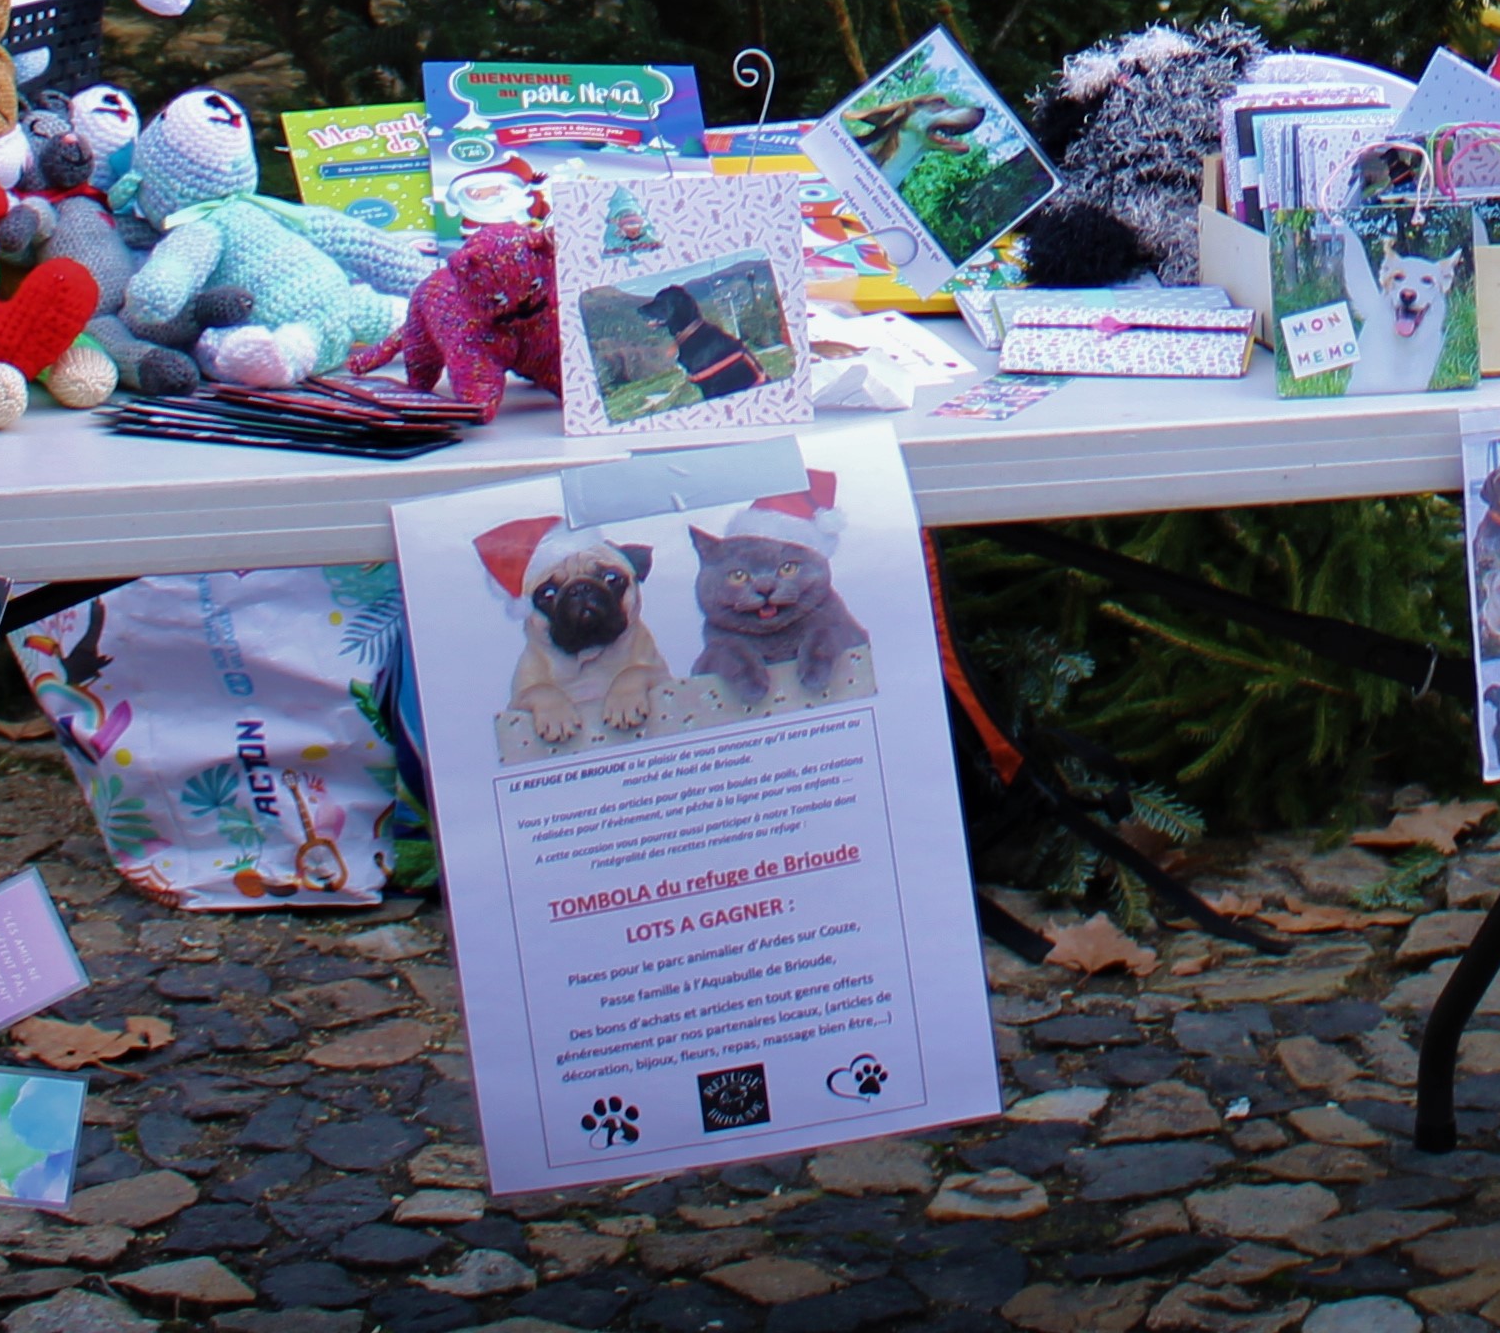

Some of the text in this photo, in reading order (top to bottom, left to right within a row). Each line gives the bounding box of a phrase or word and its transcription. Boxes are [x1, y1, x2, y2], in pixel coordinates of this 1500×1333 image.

[468, 73, 572, 85] BIENVENUE
[499, 89, 517, 97] au
[521, 85, 575, 108] pôle
[308, 121, 373, 149] Mes
[387, 133, 420, 154] de
[1292, 310, 1342, 339] MON
[1297, 340, 1356, 366] MEMO
[509, 780, 522, 794] LE
[522, 773, 563, 791] REFUGE
[564, 770, 579, 783] DE
[579, 761, 627, 780] BRIOUDE
[627, 761, 635, 771] a
[636, 758, 646, 769] le
[647, 753, 678, 769] plaisir
[678, 750, 692, 761] de
[693, 746, 716, 758] vous
[717, 737, 763, 754] annoncer
[787, 729, 808, 741] sera
[809, 720, 846, 738] présent
[847, 719, 861, 729] au
[622, 770, 660, 788] marché
[660, 768, 674, 781] de
[675, 763, 699, 778] Noël
[699, 761, 713, 774] de
[517, 817, 542, 830] Vous
[543, 816, 551, 828] y
[551, 806, 598, 824] trouverez
[598, 802, 617, 815] des
[617, 796, 654, 812] articles
[654, 791, 679, 806] pour
[679, 786, 707, 802] gâter
[708, 782, 725, 794] vos
[726, 776, 759, 791] boules
[759, 772, 773, 784] de
[800, 764, 818, 776] des
[819, 756, 864, 773] créations
[547, 841, 861, 919] TOMBOLA du refuge de Brioude
[625, 898, 784, 944] LOTS A GAGNER
[12, 936, 33, 965] AMIS
[26, 965, 41, 983] NE
[567, 970, 608, 987] Places
[609, 964, 640, 982] pour
[642, 960, 655, 973] le
[656, 956, 685, 973] parc
[686, 944, 745, 965] animalier
[796, 929, 817, 944] sur
[818, 921, 861, 938] Couze,
[599, 993, 636, 1009] Passe
[637, 983, 681, 1001] famille
[683, 980, 692, 993] à
[765, 963, 782, 977] de
[784, 953, 837, 974] Brioude,
[556, 990, 892, 1067] généreusement par nos partenaires locaux, (articles de
[569, 1028, 594, 1042] Des
[595, 1022, 627, 1037] bons
[683, 1007, 698, 1021] et
[699, 1000, 745, 1018] articles
[746, 996, 764, 1008] en
[764, 989, 793, 1005] tout
[794, 983, 830, 1002] genre
[832, 974, 874, 992] offerts
[561, 1063, 634, 1084] décoration,
[635, 1055, 678, 1072] bijoux,
[679, 1047, 720, 1062] fleurs,
[721, 1039, 761, 1055] repas,
[762, 1028, 816, 1047] massage
[818, 1022, 846, 1037] bien
